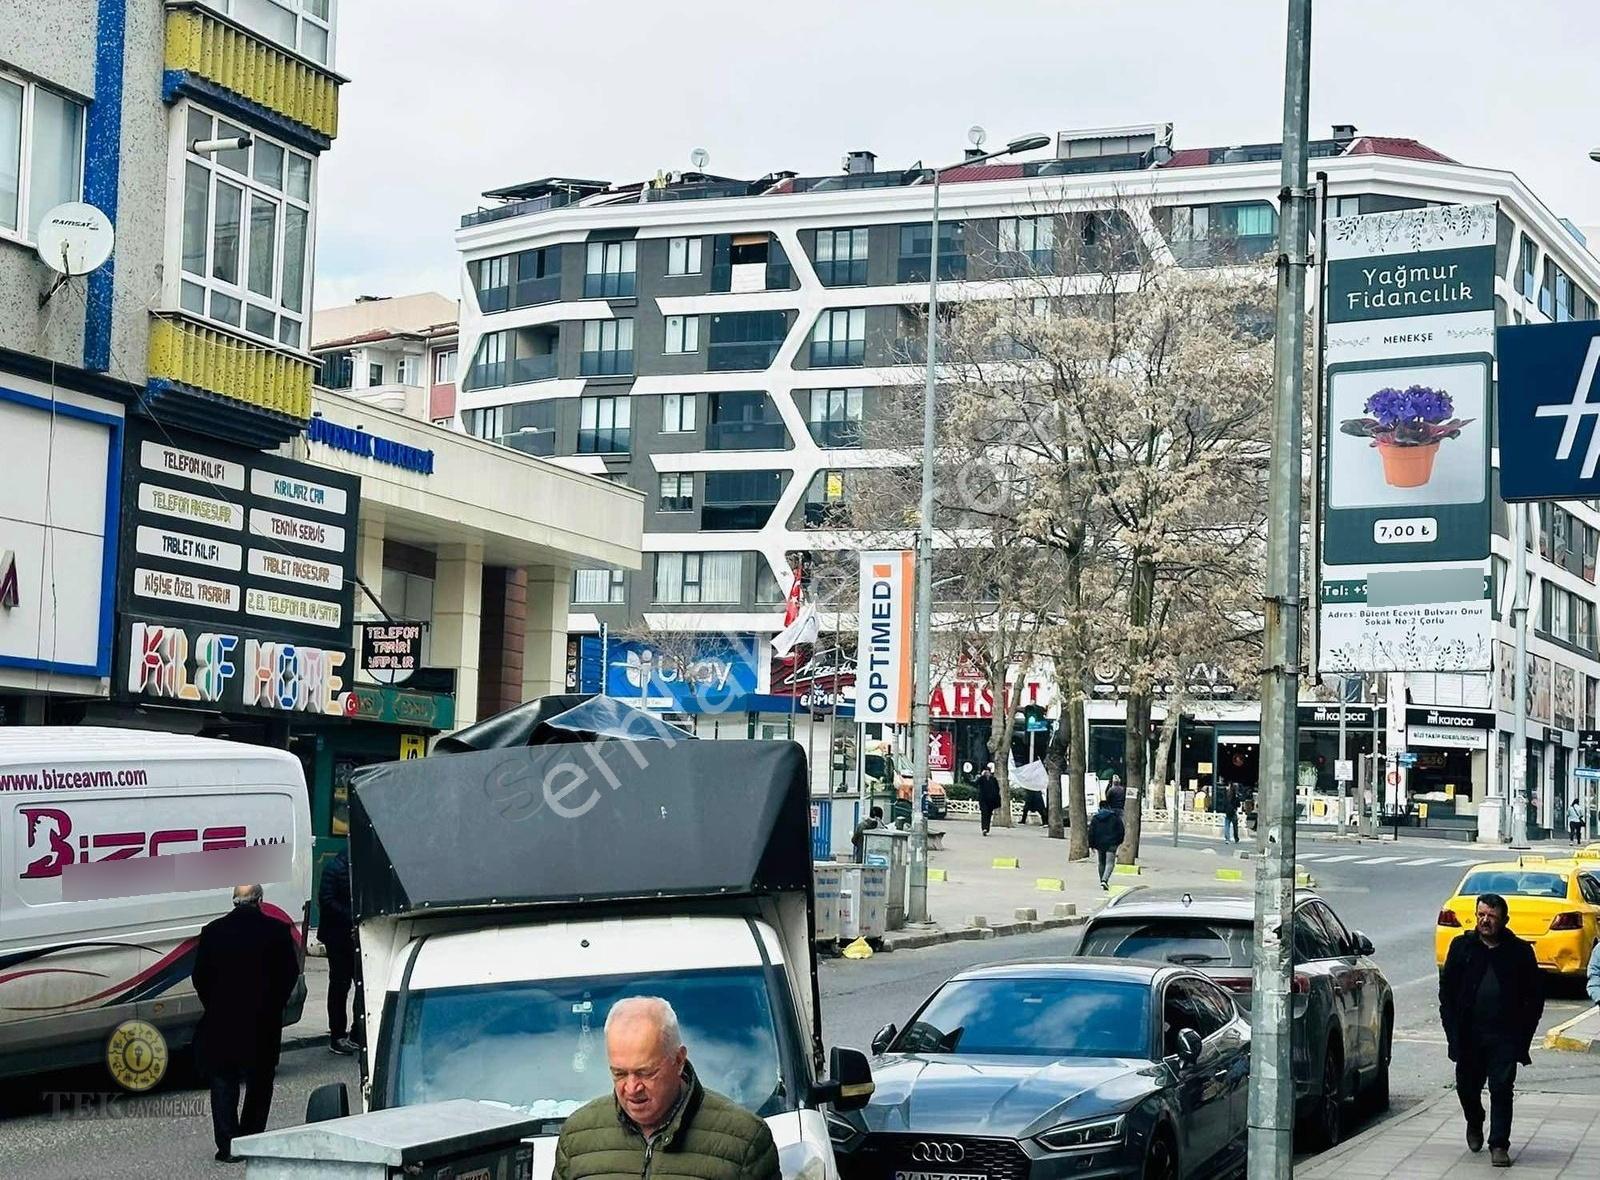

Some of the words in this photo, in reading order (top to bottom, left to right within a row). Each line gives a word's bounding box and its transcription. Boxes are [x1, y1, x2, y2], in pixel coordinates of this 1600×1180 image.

[1362, 263, 1458, 288] Yağmur
[1347, 283, 1473, 310] Fidancılık
[1383, 332, 1433, 345] MENEKŞE
[163, 450, 200, 474] TELEFON
[201, 460, 224, 480] KILIFI
[153, 490, 189, 515] TELEFON
[271, 518, 298, 539] TEKNİK
[299, 524, 325, 544] SERVİS
[1380, 525, 1415, 540] 7,00
[162, 535, 193, 557] TABLET
[194, 542, 219, 561] KILIFI
[263, 555, 291, 576] TABLET
[173, 576, 195, 600] ÖZEL
[1323, 584, 1349, 596] Tel:
[1359, 610, 1390, 618] Bülent
[1392, 609, 1421, 617] Ecevit
[1461, 607, 1484, 616] Onur
[1365, 617, 1392, 626] Sokak
[366, 626, 420, 640] TELEFON
[243, 639, 347, 716] HOME
[1326, 711, 1366, 721] kaaca
[1438, 715, 1474, 727] karaca
[0, 768, 148, 792] www.bizceavm.com
